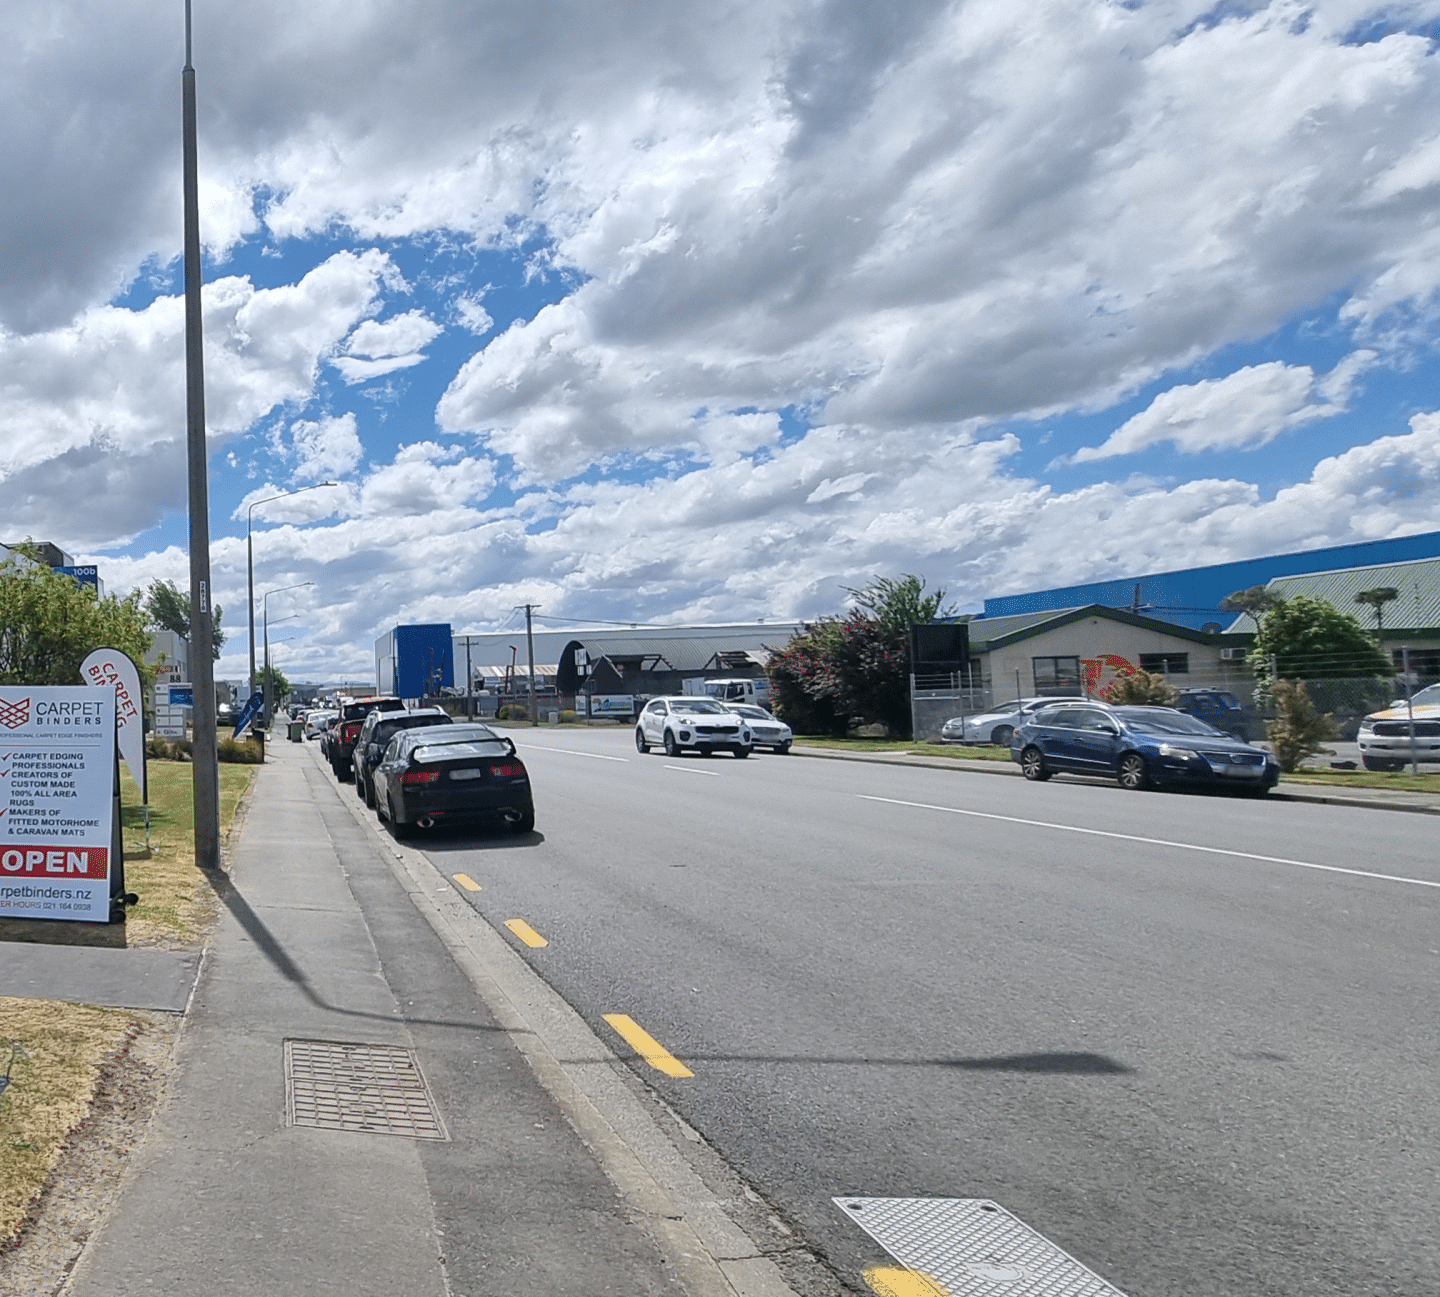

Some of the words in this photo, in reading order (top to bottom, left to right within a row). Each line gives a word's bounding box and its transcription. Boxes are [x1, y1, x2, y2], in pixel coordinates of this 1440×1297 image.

[73, 567, 96, 576] 100b
[170, 674, 181, 683] 88
[102, 663, 138, 717] CARPET
[36, 702, 103, 715] CARPET
[36, 717, 101, 725] BINDERS
[9, 808, 46, 816] MAKERS
[8, 818, 39, 826] FITTED
[41, 819, 99, 827] MOTORHOME
[16, 828, 58, 836] CARAVAN
[1, 850, 88, 873] OPEN
[13, 901, 41, 909] HOURS
